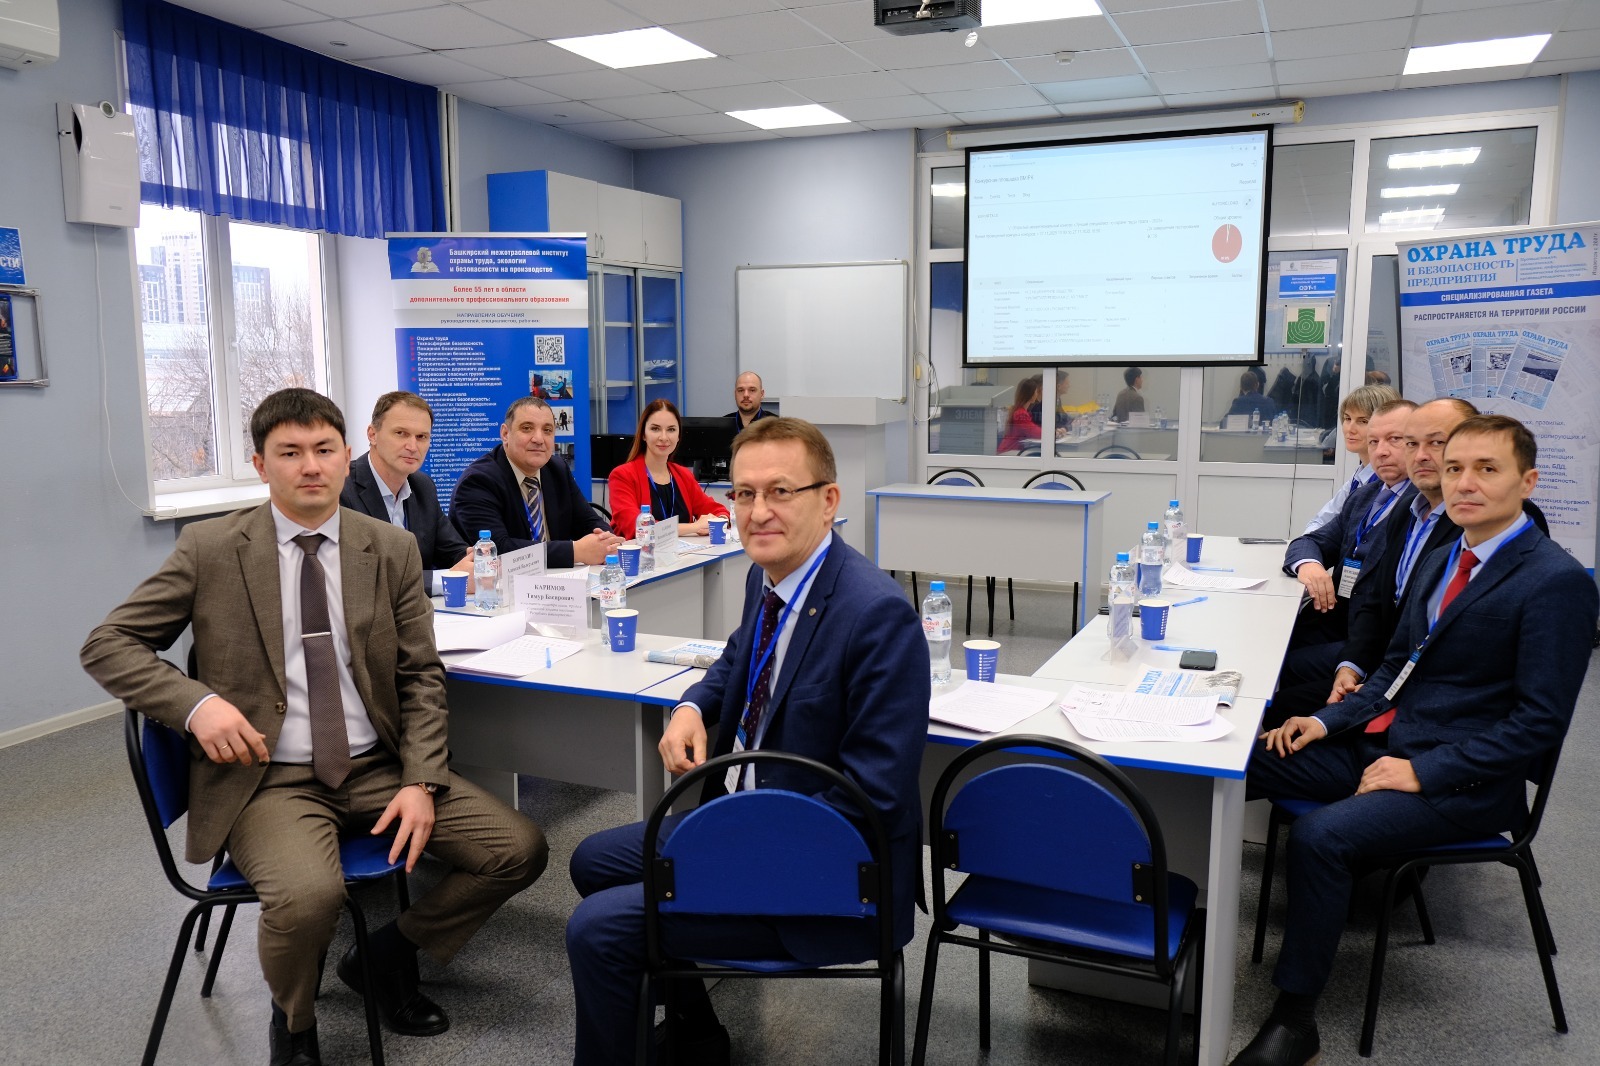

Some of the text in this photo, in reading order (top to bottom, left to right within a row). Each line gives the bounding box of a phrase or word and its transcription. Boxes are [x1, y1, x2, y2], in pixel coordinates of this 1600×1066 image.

[450, 249, 489, 257] Башкирский
[1407, 232, 1586, 262] ОХРАНА ТРУДА
[1418, 260, 1514, 275] БЕЗОПАСНОСТЬ
[1408, 273, 1496, 287] ПРЕДПРИЯТИЯ
[1441, 287, 1553, 302] СПЕЦИАЛИЗИРОВАННАЯ ГАЗЕТА
[1414, 311, 1487, 321] РАСПРОСТРАНЯЕТСЯ
[1502, 308, 1550, 317] ТЕРРИТОРИИ
[1552, 305, 1586, 315] РОССИИ
[1426, 333, 1470, 346] ОХРАНА ТРУДА
[1522, 330, 1569, 350] ОХРАНА ТРУДА
